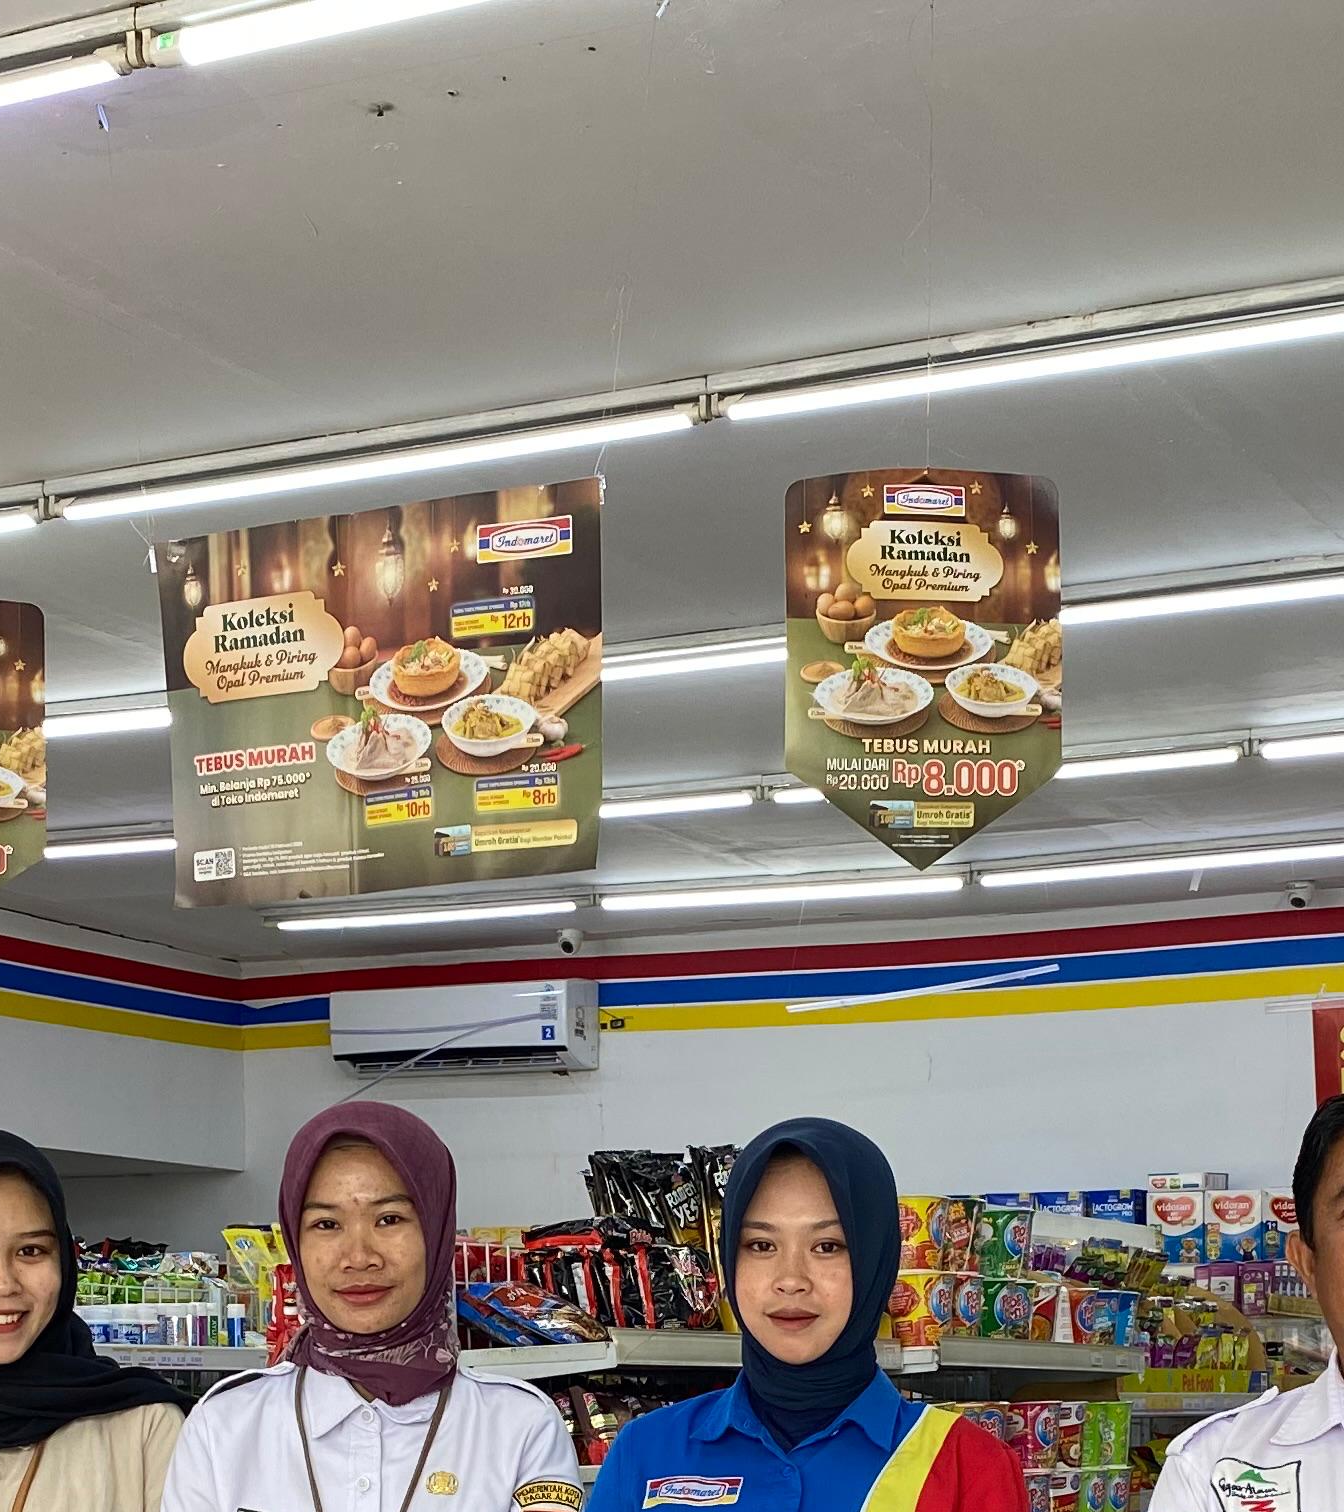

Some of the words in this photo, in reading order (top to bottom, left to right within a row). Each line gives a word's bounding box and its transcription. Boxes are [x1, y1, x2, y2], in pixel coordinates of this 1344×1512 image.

[890, 529, 961, 548] Koleksi
[881, 546, 971, 563] Ramadan
[869, 565, 928, 579] Mangkuk
[931, 567, 940, 577] &
[943, 566, 981, 581] Piring
[881, 578, 912, 591] Opal
[915, 579, 970, 592] Premium
[221, 603, 295, 633] Koleksi
[501, 612, 531, 629] 12rb
[213, 626, 305, 654] Ramadan
[862, 739, 919, 754] TEBUS
[924, 740, 990, 754] MURAH
[195, 752, 246, 775] TEBUS
[248, 743, 316, 768] MURAH
[826, 758, 861, 771] MULAI
[863, 758, 889, 771] DARI
[200, 784, 219, 796] Min.
[222, 778, 256, 794] Belanja
[257, 777, 271, 790] Rp
[221, 793, 244, 806] Toko
[245, 788, 299, 804] Indomaret
[532, 788, 556, 806] 8rb
[405, 801, 431, 820] 10rb
